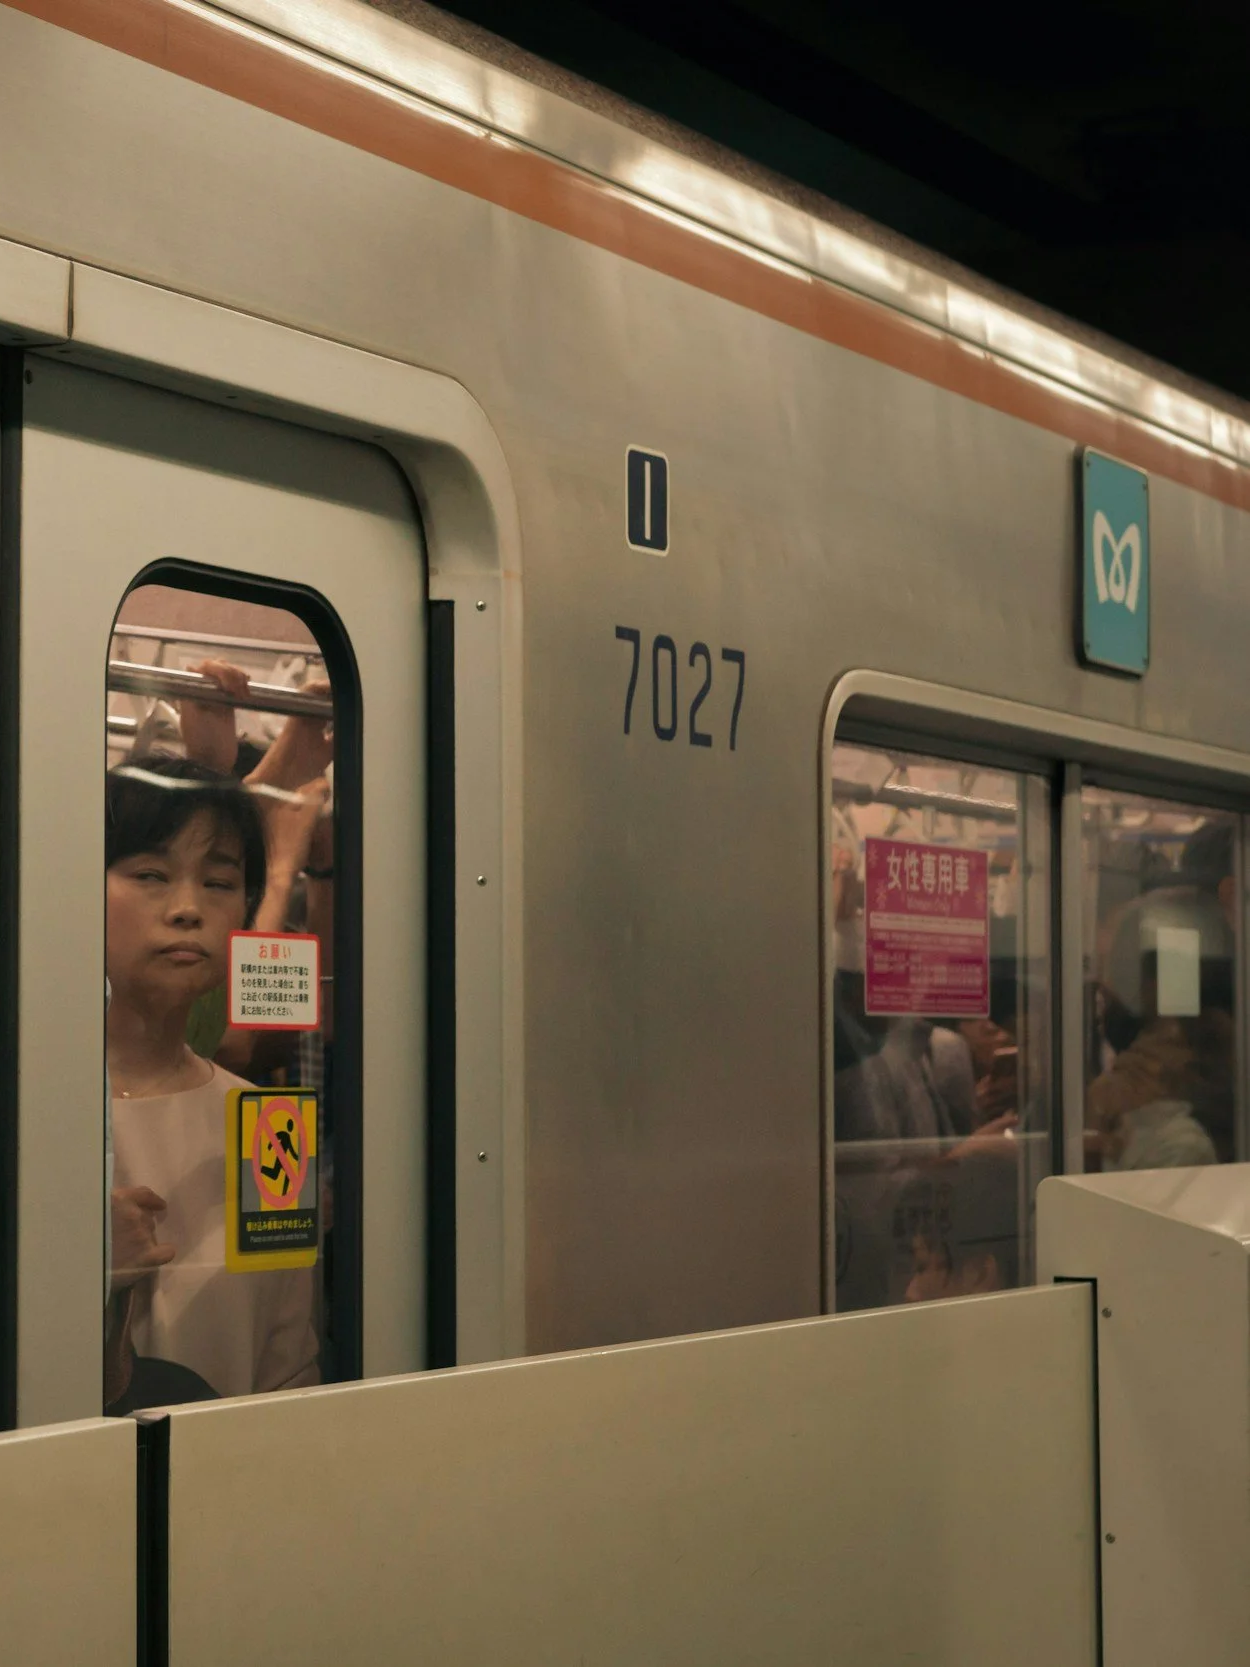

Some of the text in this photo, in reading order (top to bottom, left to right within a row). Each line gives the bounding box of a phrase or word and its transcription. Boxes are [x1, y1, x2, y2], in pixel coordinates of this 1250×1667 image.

[615, 626, 745, 751] 7027
[887, 848, 969, 897] 女性専用車
[259, 943, 291, 959] お願い
